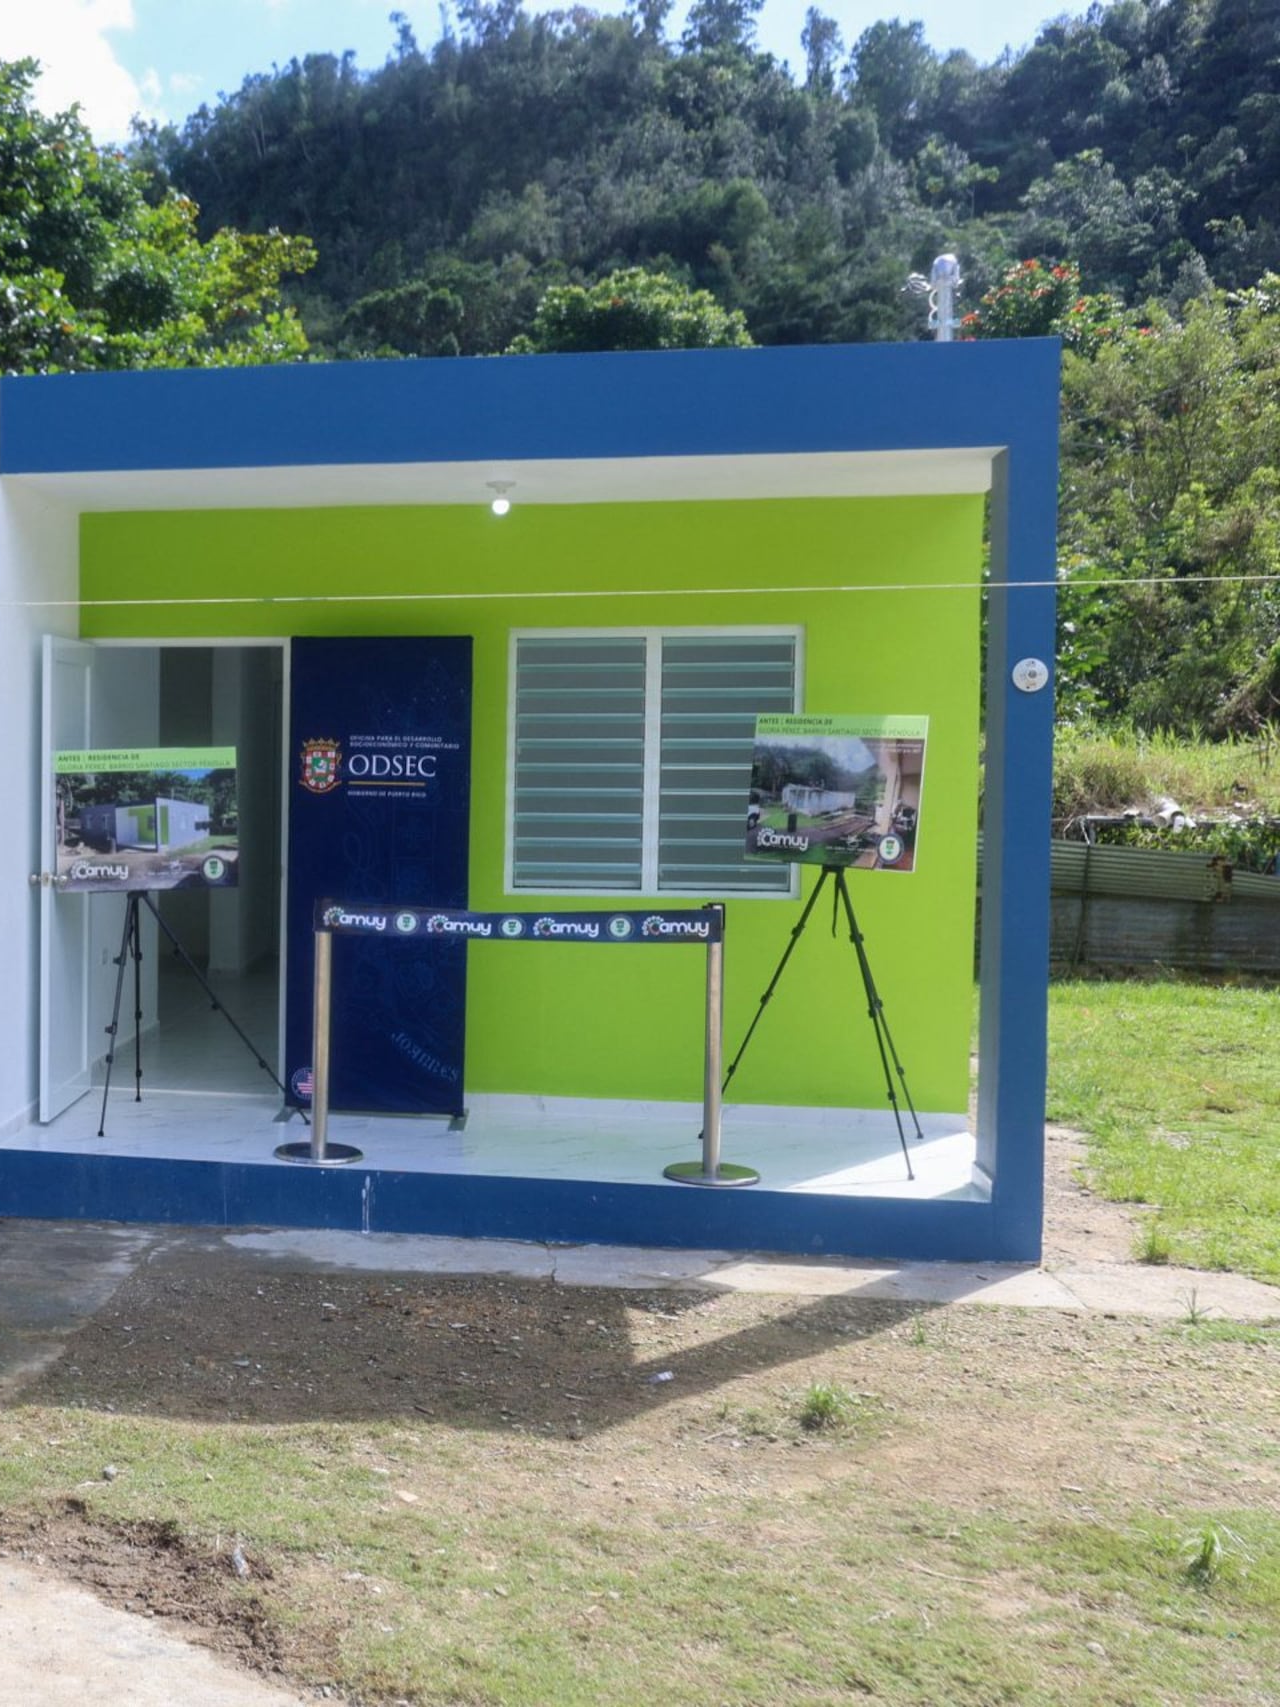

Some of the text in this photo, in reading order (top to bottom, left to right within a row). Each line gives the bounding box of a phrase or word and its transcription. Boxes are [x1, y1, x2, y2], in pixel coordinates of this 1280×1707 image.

[759, 717, 833, 726] ANTES RESIDENCIA DE
[377, 735, 393, 743] PARA
[402, 735, 443, 744] DESARROLLO
[415, 742, 460, 750] COMUNITARIO
[58, 752, 140, 763] ANTES RESIDENCIA DE
[348, 754, 437, 777] ODSEC
[757, 828, 808, 851] Camuy
[71, 860, 129, 880] Camuy
